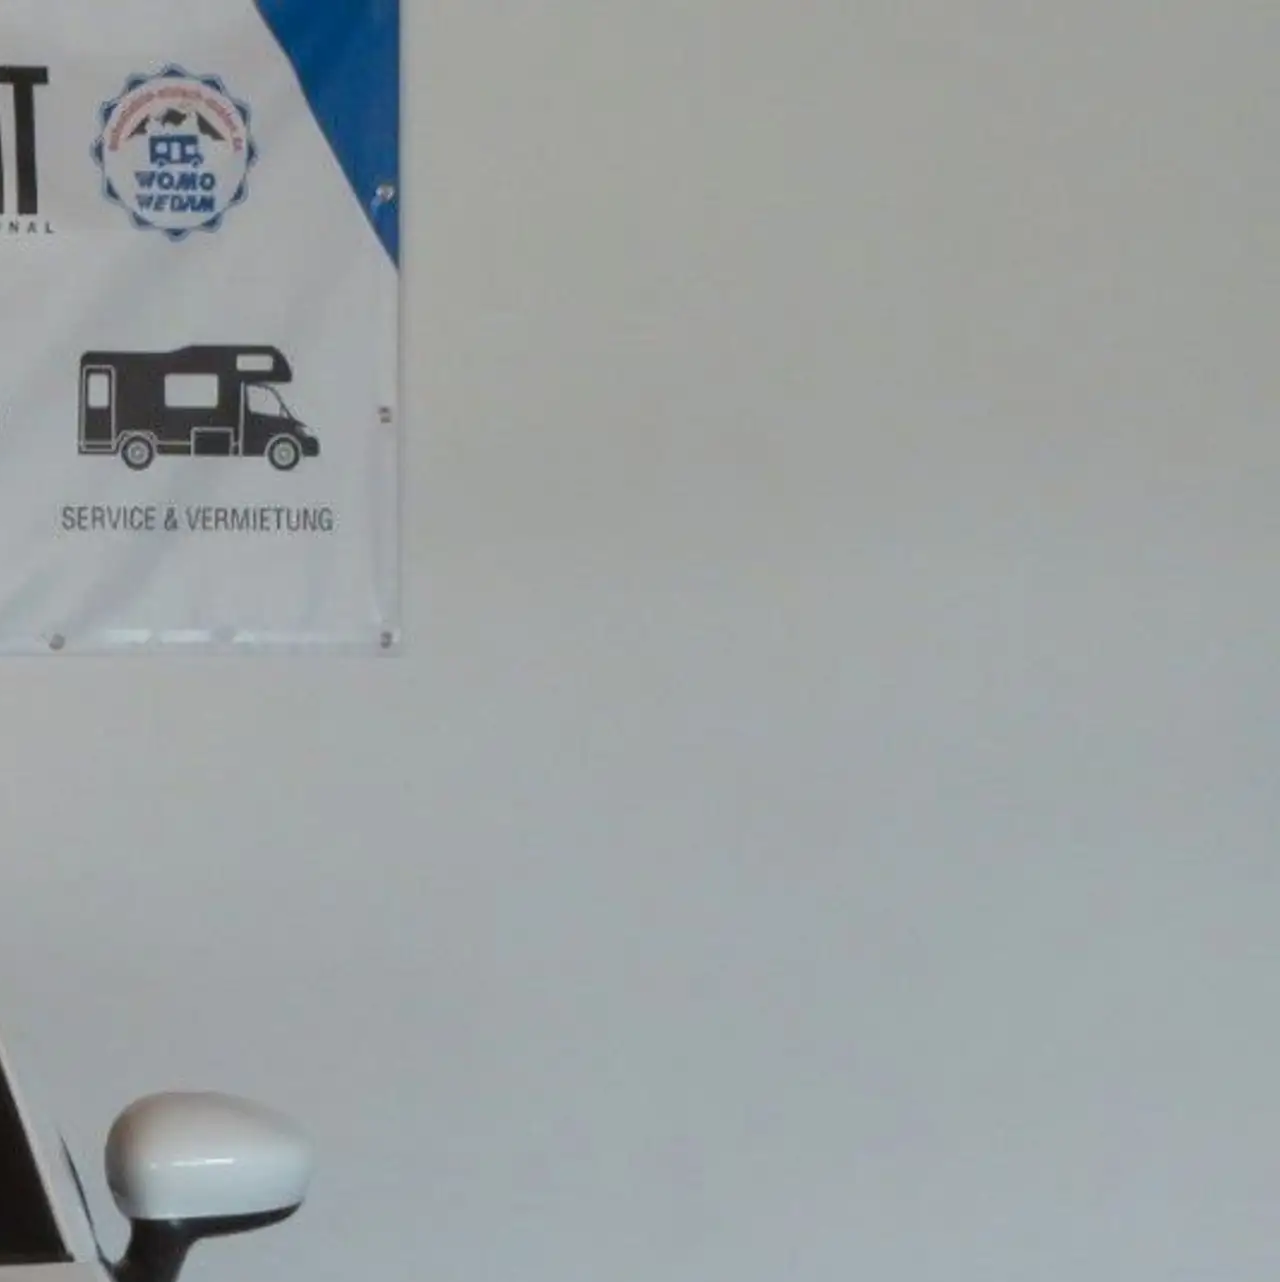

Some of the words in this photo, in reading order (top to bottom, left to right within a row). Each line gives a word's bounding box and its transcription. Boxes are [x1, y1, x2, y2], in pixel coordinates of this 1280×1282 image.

[134, 170, 216, 191] WOMO
[60, 505, 157, 531] SERVICE
[163, 505, 178, 531] &
[185, 505, 334, 532] VERMIETUNG
